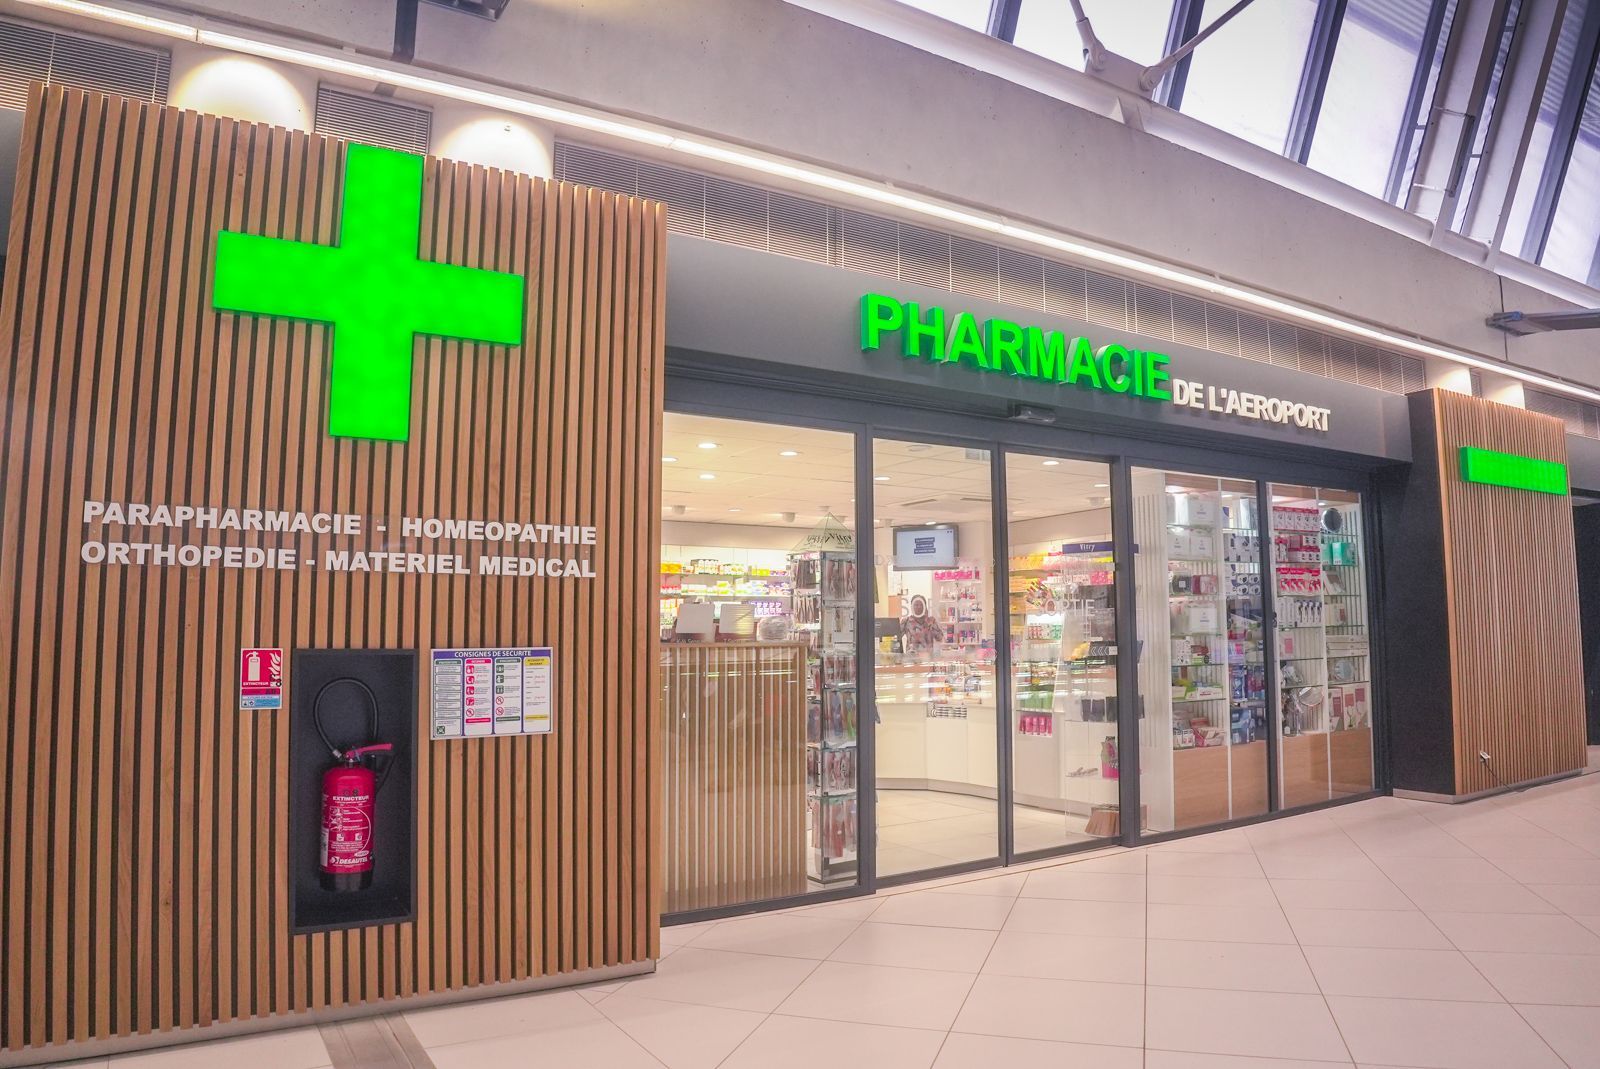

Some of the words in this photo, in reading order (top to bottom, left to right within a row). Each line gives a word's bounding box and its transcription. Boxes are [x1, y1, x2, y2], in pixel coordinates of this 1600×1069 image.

[861, 293, 1172, 401] PHARMACIE
[1172, 378, 1204, 409] DE
[1208, 385, 1331, 432] L'AEROPORT
[83, 500, 361, 535] PARAPHARMACIE
[402, 517, 597, 545] HOMEOPATHIE
[81, 541, 297, 570] ORTHOPEDIE
[325, 550, 471, 575] MATERIEL
[479, 555, 597, 578] MEDICAL
